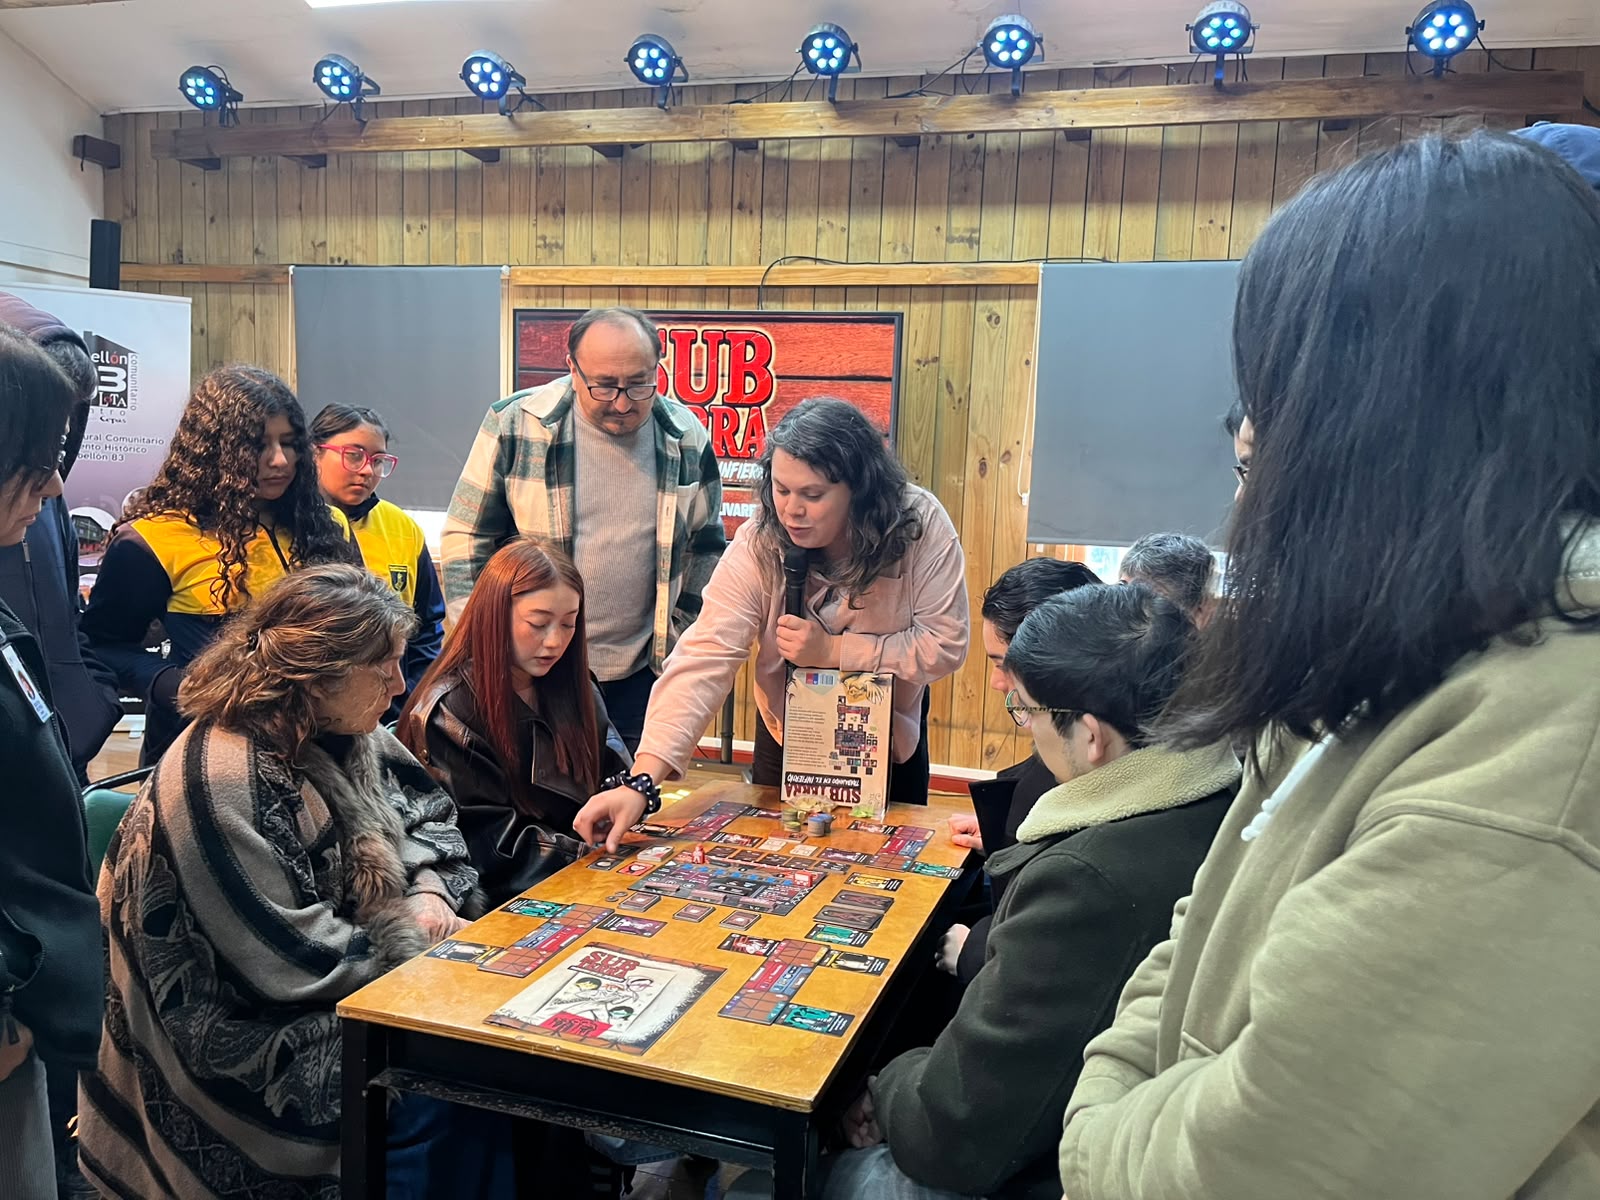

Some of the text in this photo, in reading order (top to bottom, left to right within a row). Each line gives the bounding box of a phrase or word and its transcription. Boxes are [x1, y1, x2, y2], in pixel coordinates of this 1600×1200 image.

[91, 350, 128, 365] ellón
[98, 365, 127, 392] 3
[130, 354, 138, 411] comunitario
[83, 433, 165, 445] ural Comunitario
[687, 404, 768, 460] RA
[104, 443, 147, 454] Histórico
[111, 453, 125, 461] 83
[590, 951, 640, 971] SUB
